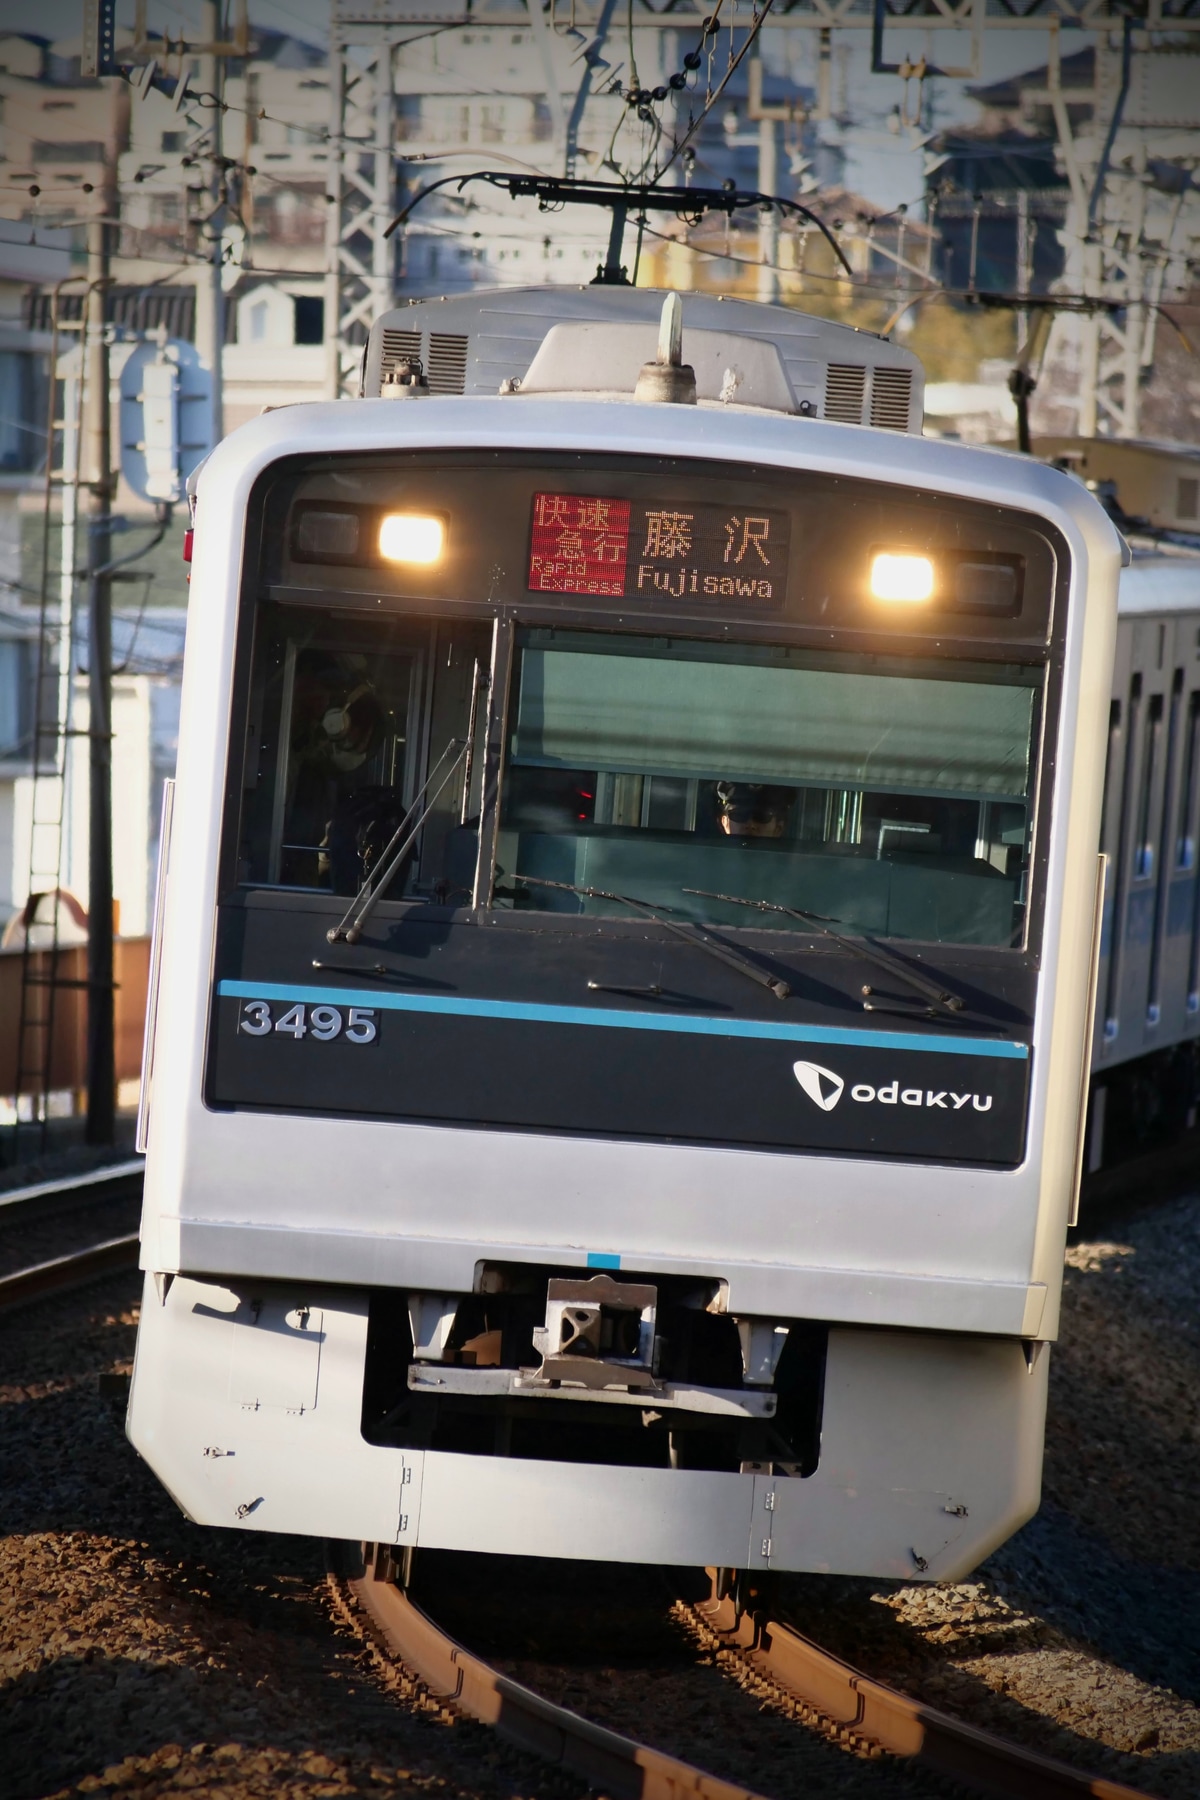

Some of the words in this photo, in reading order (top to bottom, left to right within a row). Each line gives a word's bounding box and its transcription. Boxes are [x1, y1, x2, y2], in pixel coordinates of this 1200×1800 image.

[535, 495, 611, 531] 快速
[554, 529, 626, 562] 急行
[642, 511, 770, 566] 藤沢
[530, 556, 587, 577] Rapid
[637, 565, 772, 598] Fujisawa
[539, 574, 623, 595] Express
[240, 1001, 377, 1044] 3495
[851, 1081, 993, 1112] odakyu
